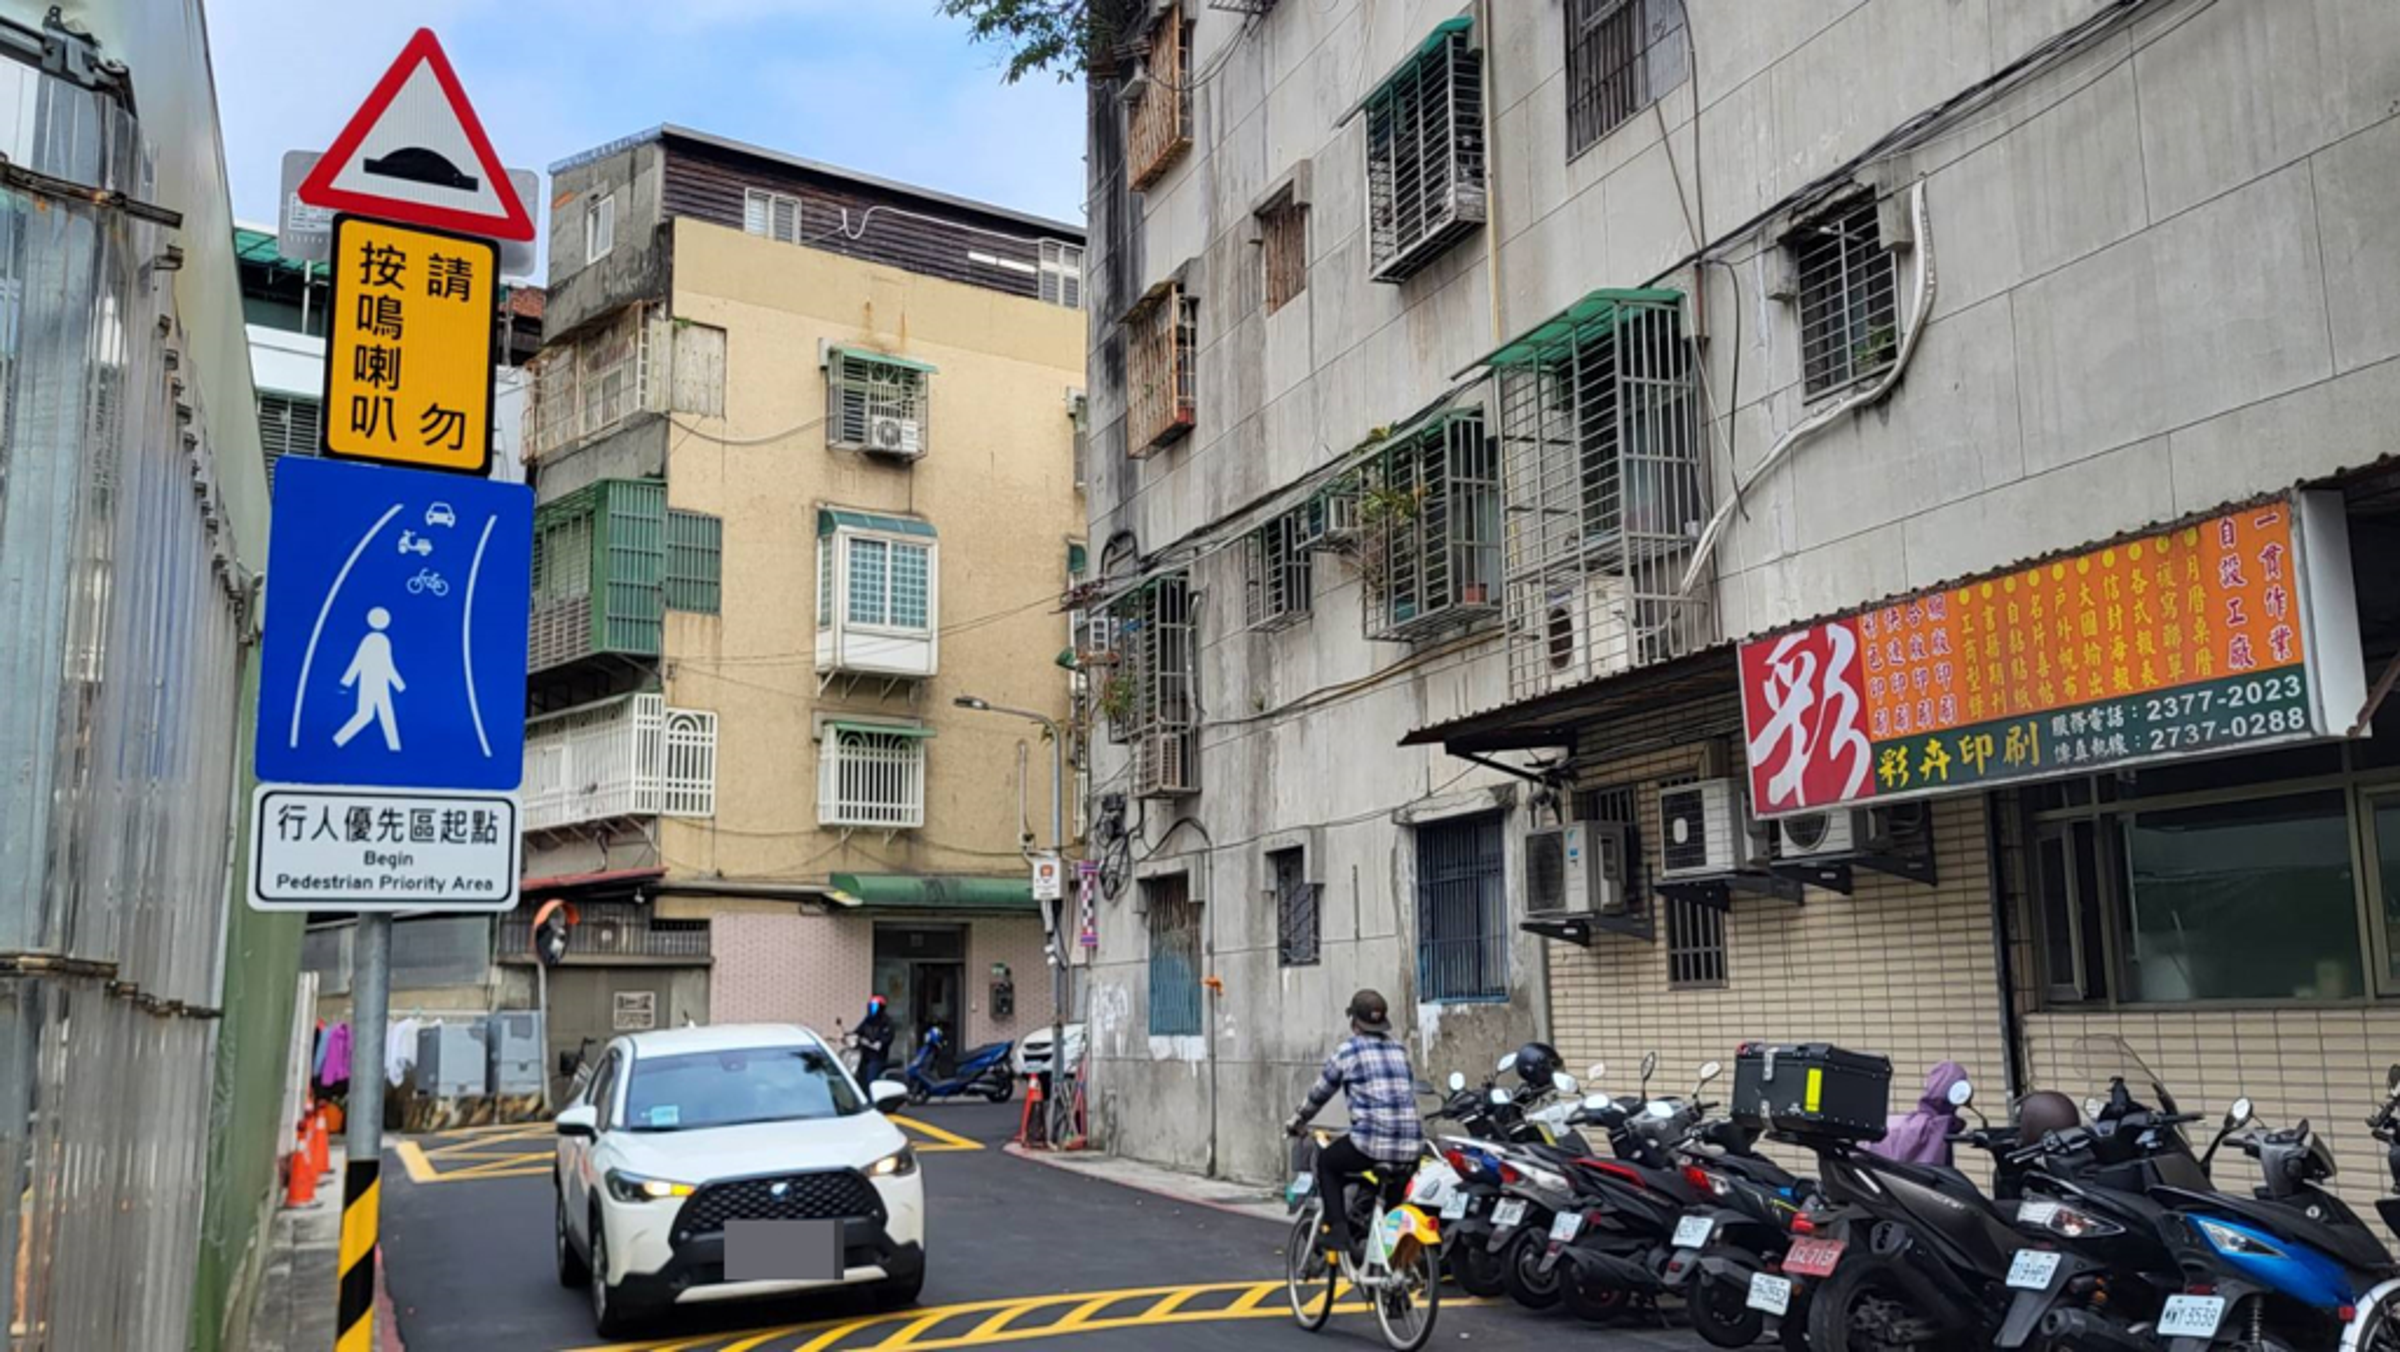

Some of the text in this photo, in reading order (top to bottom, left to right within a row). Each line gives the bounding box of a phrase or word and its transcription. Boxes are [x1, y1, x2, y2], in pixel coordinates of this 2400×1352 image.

[350, 239, 407, 443] 按鳴喇叭
[2254, 512, 2292, 662] 一貫作業
[2078, 581, 2104, 696] 大圖輸出
[2103, 573, 2133, 692] 信封海報
[2146, 675, 2301, 722] 2377-2023
[1878, 721, 2041, 788] 彩卉印刷
[2150, 706, 2305, 751] 2737-0288
[277, 803, 499, 846] 行人優先區起點
[276, 873, 494, 894] Pedestrian Priority Area
[363, 850, 414, 869] Begin
